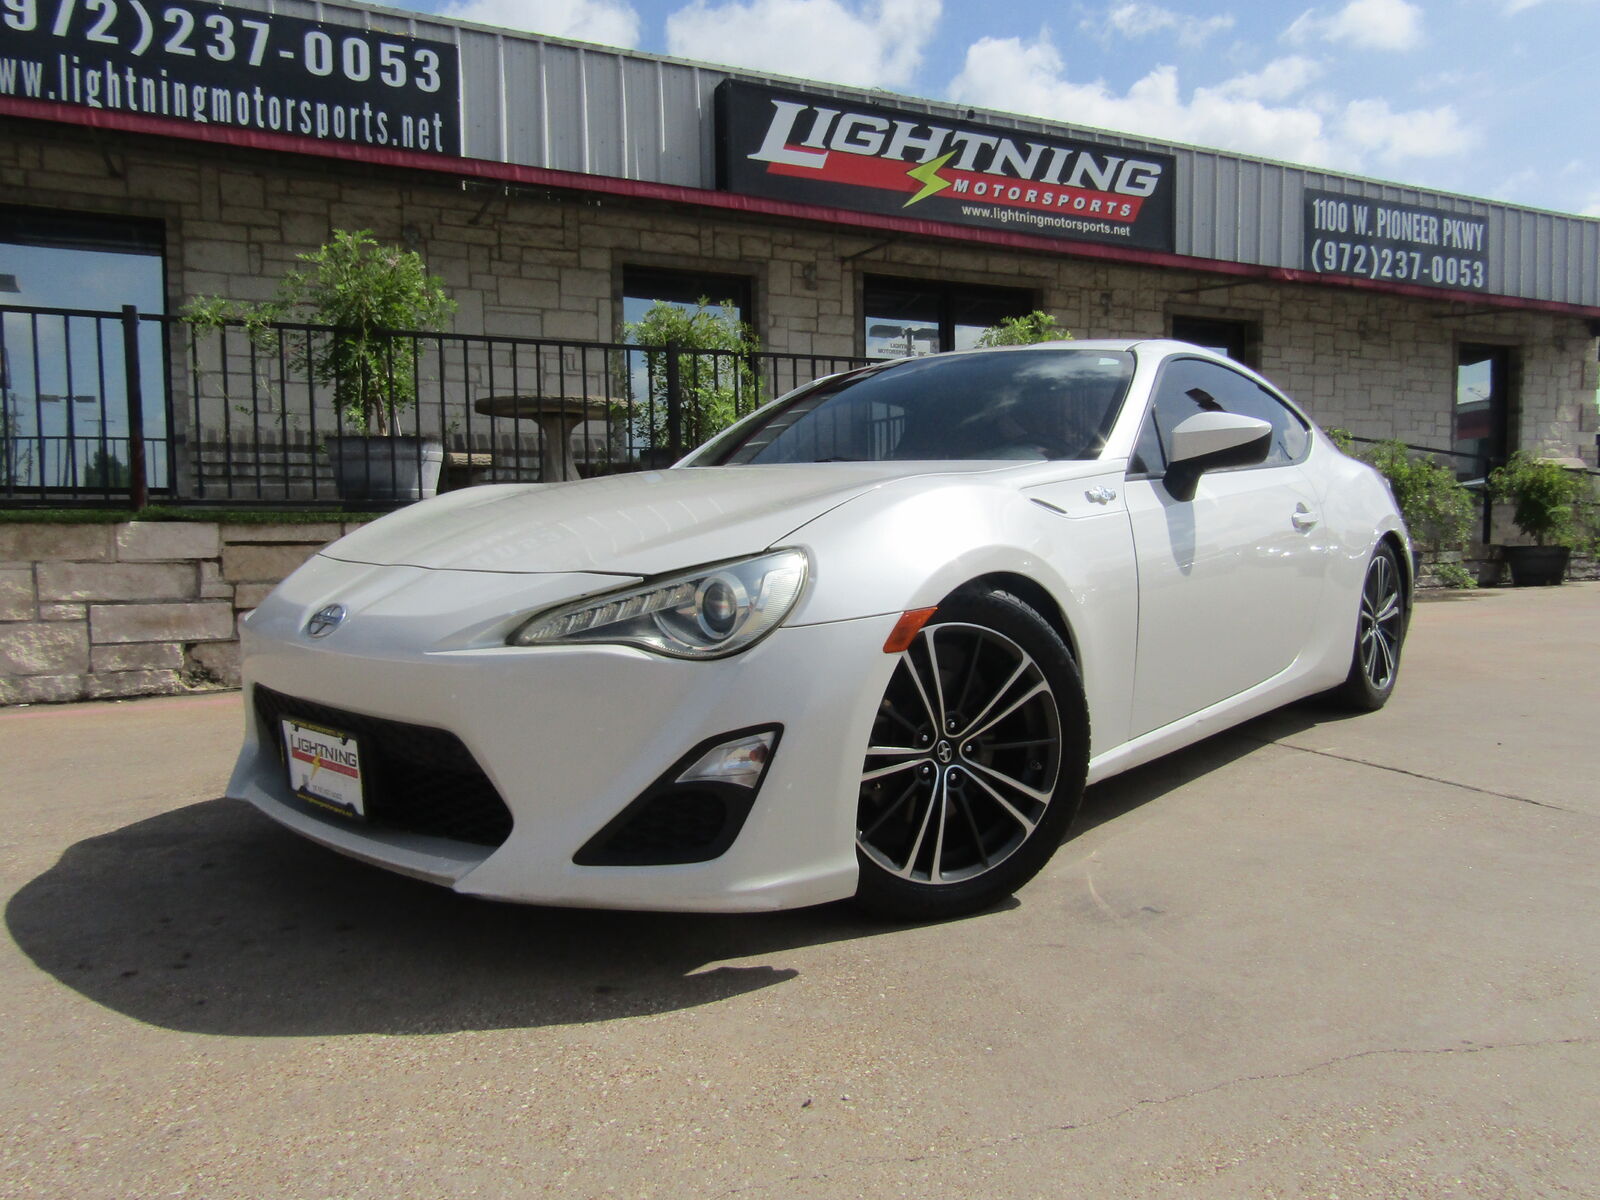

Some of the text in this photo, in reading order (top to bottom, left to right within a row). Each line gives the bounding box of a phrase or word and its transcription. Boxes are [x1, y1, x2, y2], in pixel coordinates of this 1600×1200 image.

[747, 99, 1163, 197] LIGHTNING
[953, 178, 1132, 217] MOTORSPORTS
[961, 205, 1130, 236] www.lightningmotorsports.net
[1313, 198, 1484, 251] 1100 W. PIONEER PKWY
[1311, 239, 1484, 288] (972)237-0053
[290, 734, 357, 767] LIGHTNING
